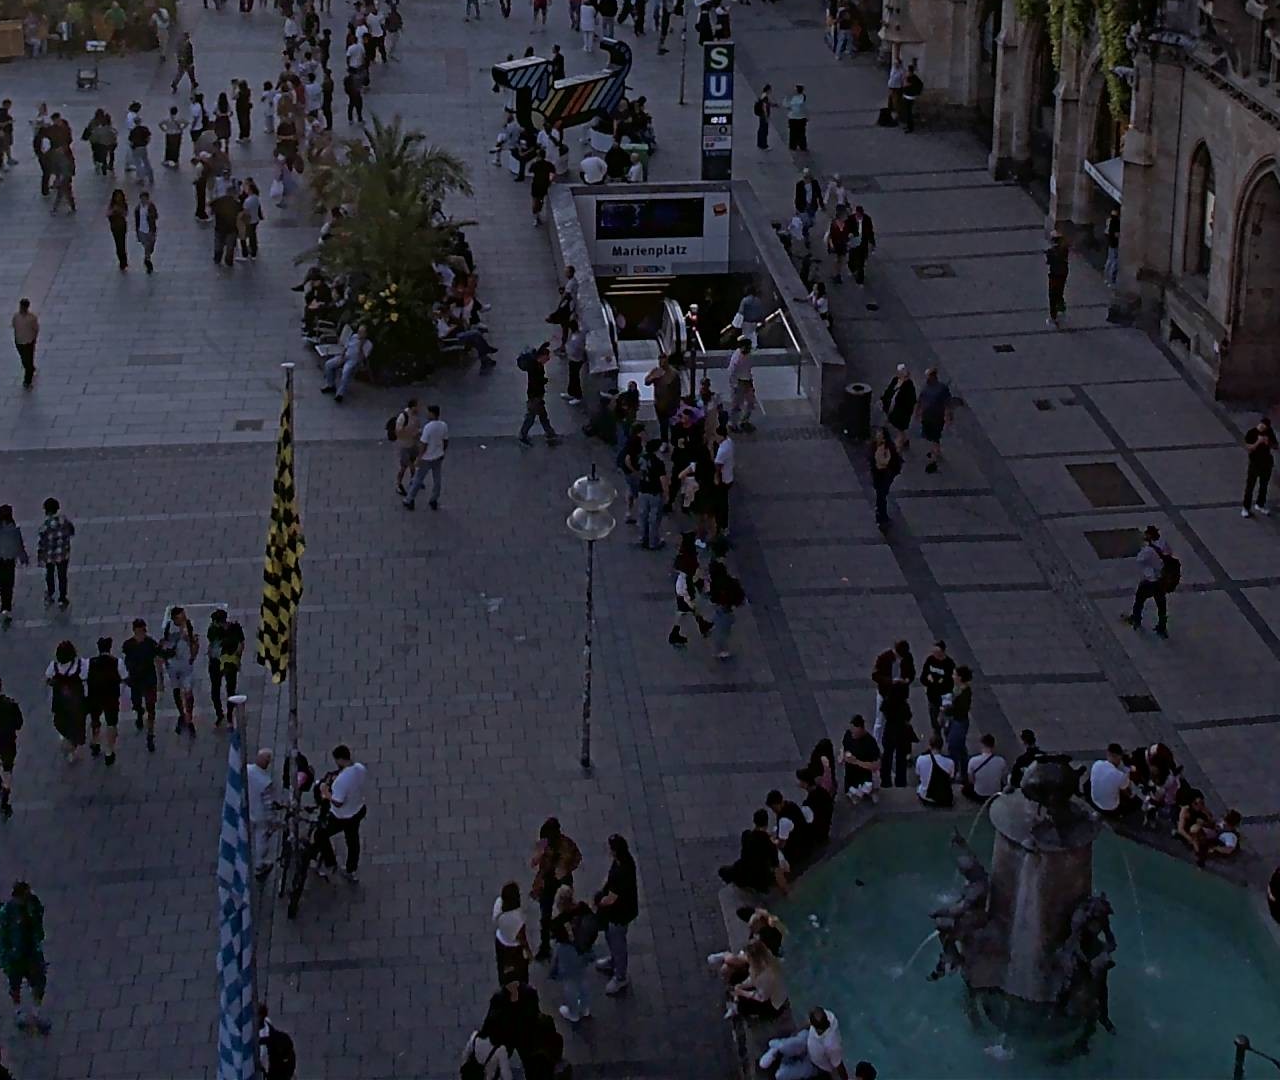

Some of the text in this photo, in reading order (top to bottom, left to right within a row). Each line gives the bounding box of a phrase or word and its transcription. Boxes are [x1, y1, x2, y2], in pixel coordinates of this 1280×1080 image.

[710, 47, 729, 69] S
[709, 75, 727, 97] U
[612, 244, 687, 258] Marienplatz
